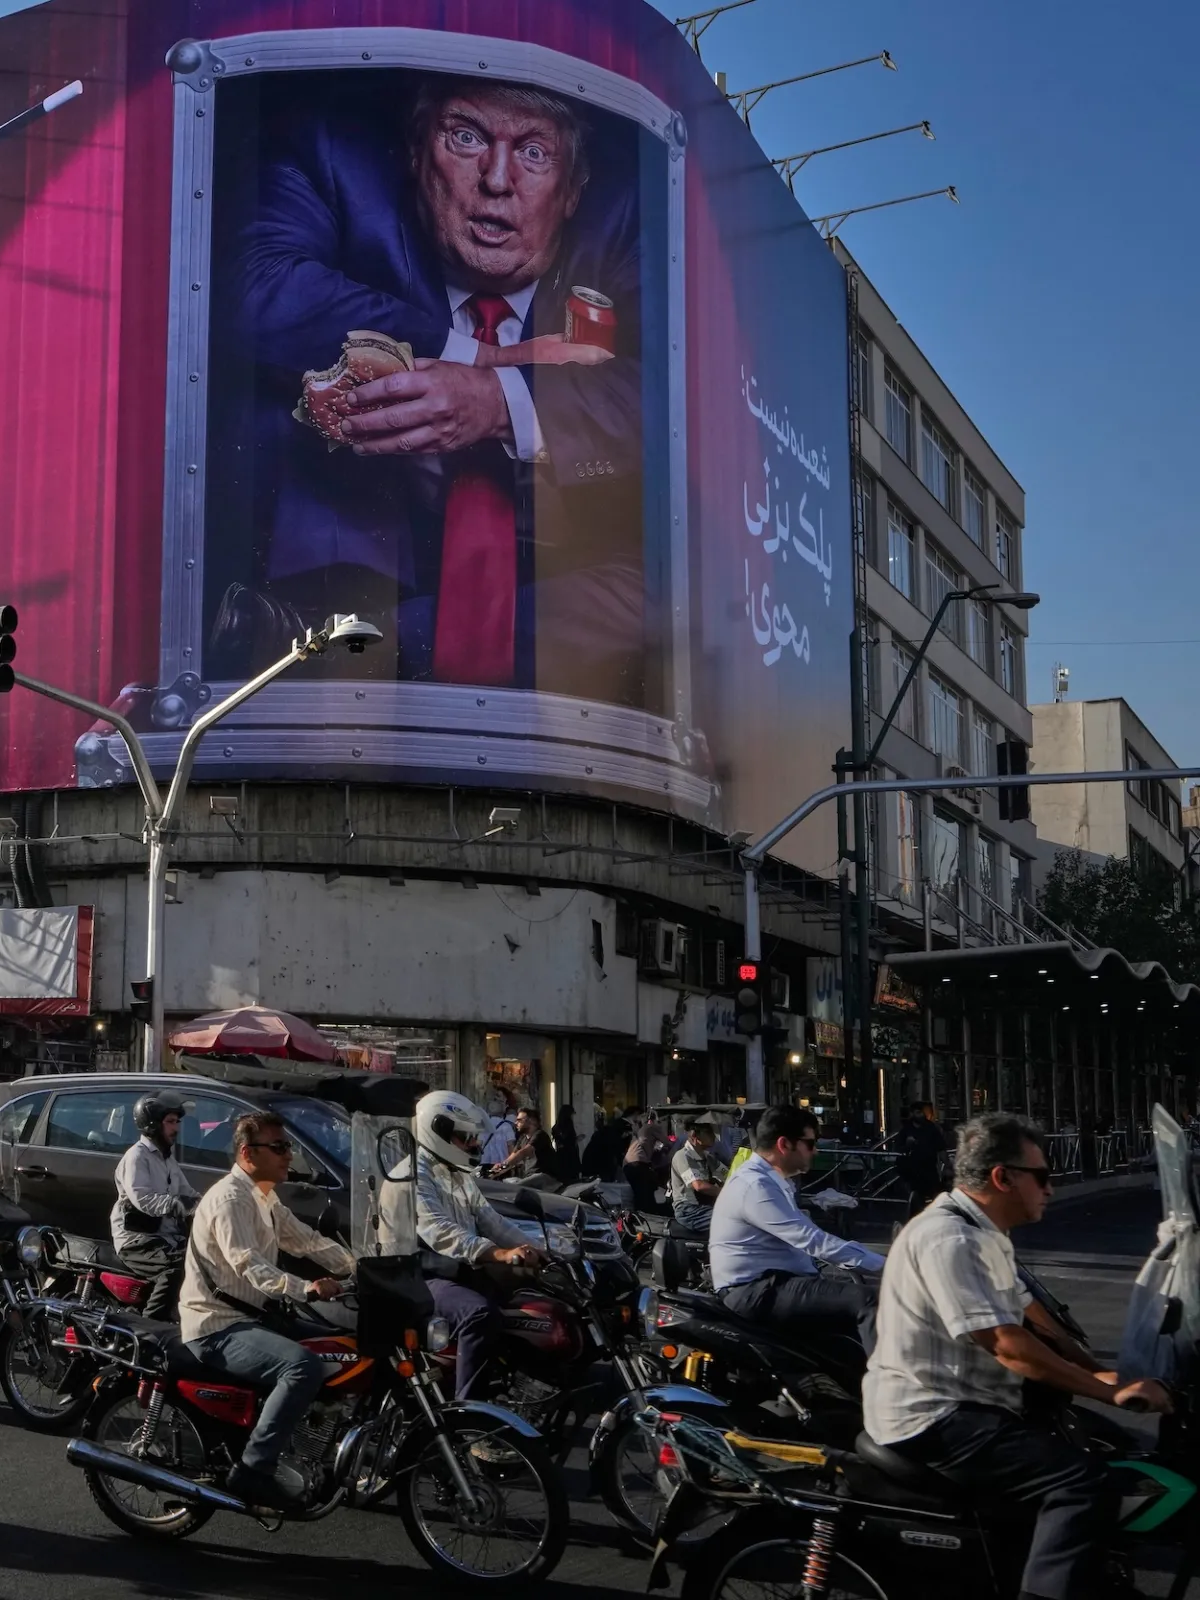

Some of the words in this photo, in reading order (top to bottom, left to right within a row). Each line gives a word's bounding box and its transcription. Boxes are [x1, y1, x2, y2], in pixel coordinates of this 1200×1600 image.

[744, 456, 790, 563] بزنی
[789, 427, 830, 490] شعبده
[792, 492, 832, 606] پلک
[744, 557, 810, 666] محوی!
